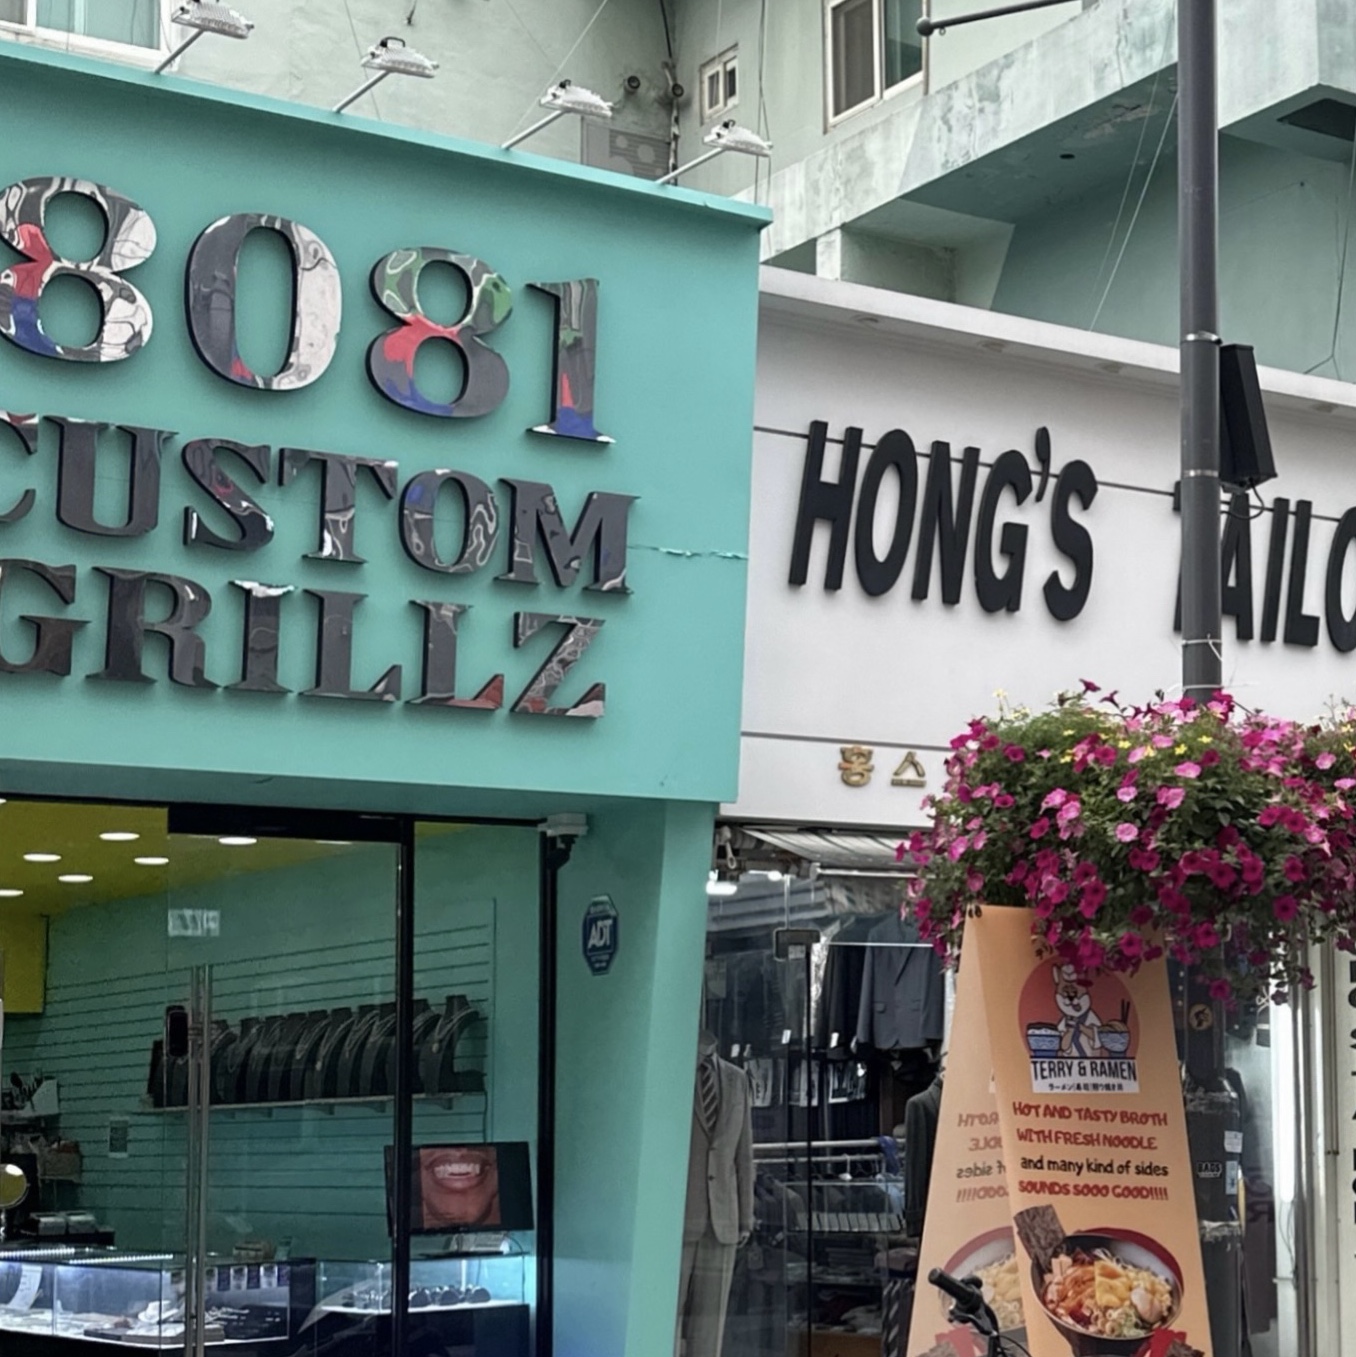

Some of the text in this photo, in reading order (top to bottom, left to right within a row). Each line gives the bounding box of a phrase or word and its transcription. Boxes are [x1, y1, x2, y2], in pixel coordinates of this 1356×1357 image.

[0, 176, 617, 443] 8081
[788, 420, 1098, 621] HONG'S
[0, 557, 607, 718] GRILLZ
[587, 919, 613, 949] ADT
[1031, 1060, 1137, 1082] TERRY & RAMEN
[1012, 1102, 1168, 1126] HOT AND TASTY BROTH
[1016, 1128, 1158, 1150] WITH FRESH NOODLE
[1020, 1155, 1169, 1177] and many kind of sides
[1018, 1180, 1169, 1201] SOUNDS SOOO GOOD!!!!
